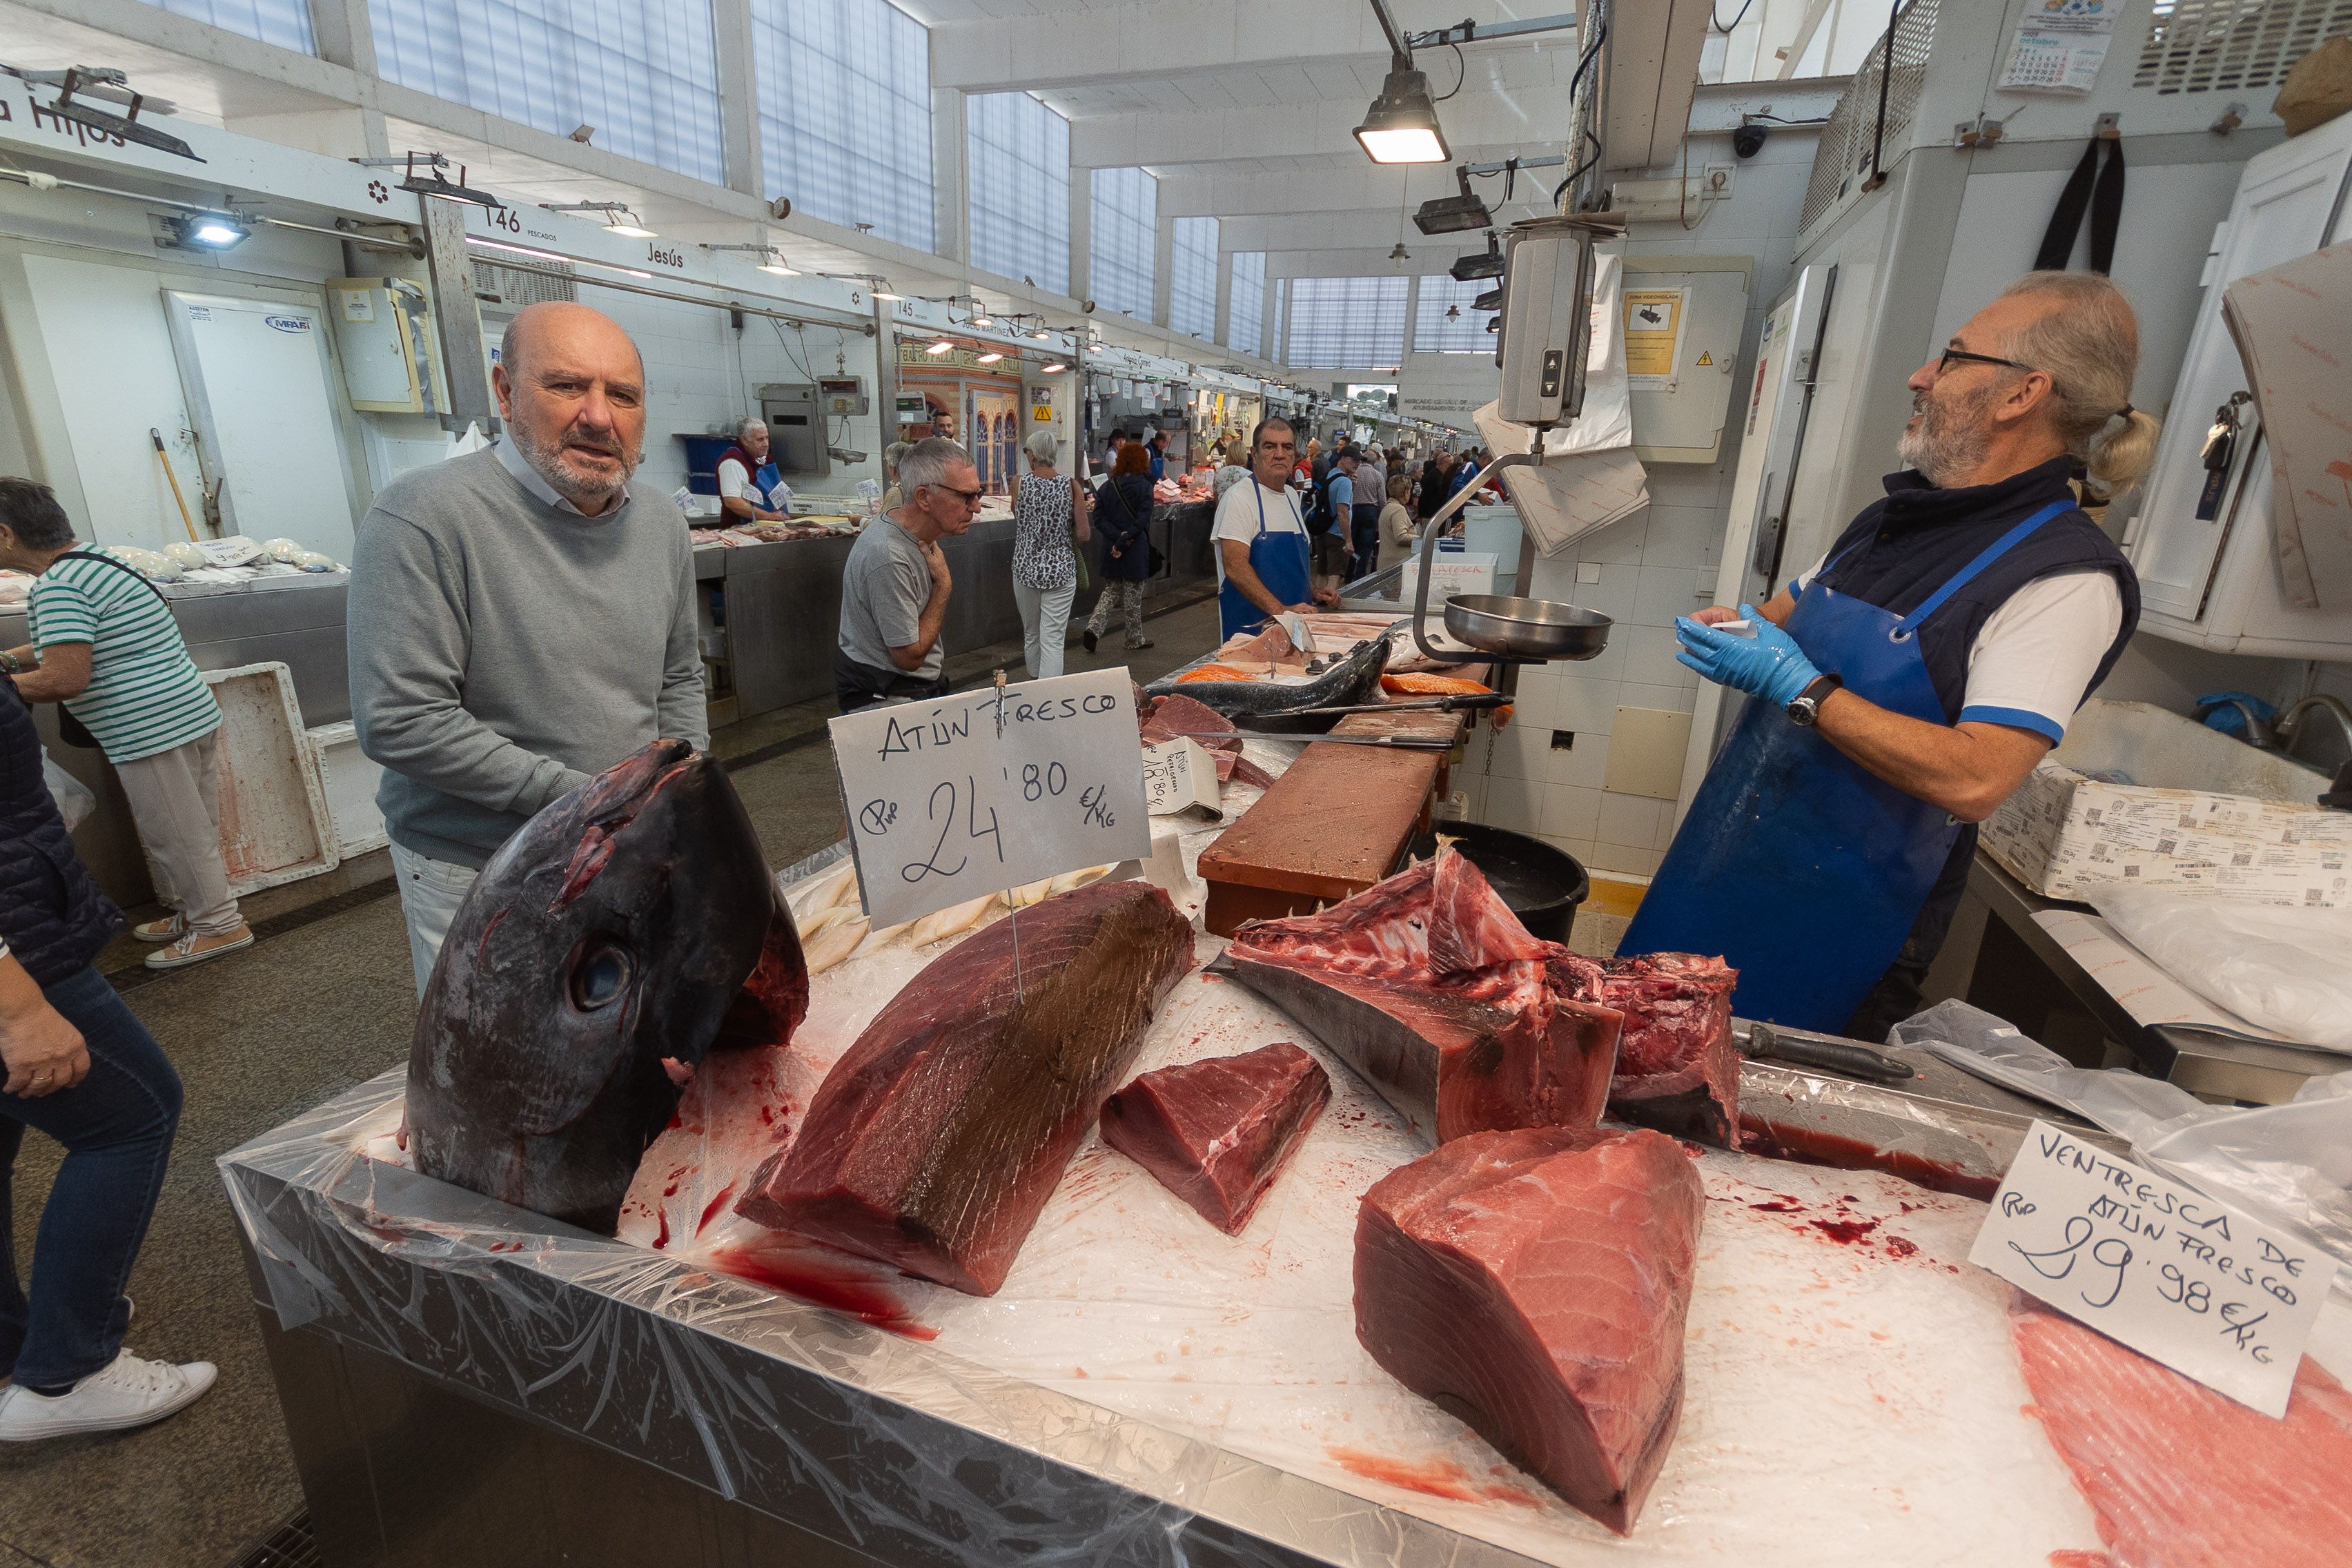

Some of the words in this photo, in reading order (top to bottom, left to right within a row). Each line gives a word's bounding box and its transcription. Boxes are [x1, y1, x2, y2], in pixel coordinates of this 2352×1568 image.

[486, 206, 520, 233] 146
[527, 230, 557, 242] PESCADOS
[647, 242, 683, 268] Jesús
[898, 300, 913, 316] 145
[878, 708, 968, 761] ATÚN
[977, 693, 1117, 726] FRESCO
[1174, 750, 1188, 774] ATÚN
[901, 761, 1068, 883] 24'80
[2040, 1133, 2232, 1241] VENTRESCA
[2257, 1237, 2306, 1278] DE
[2088, 1194, 2166, 1241] ATÚN
[2177, 1231, 2297, 1306] FRESCO
